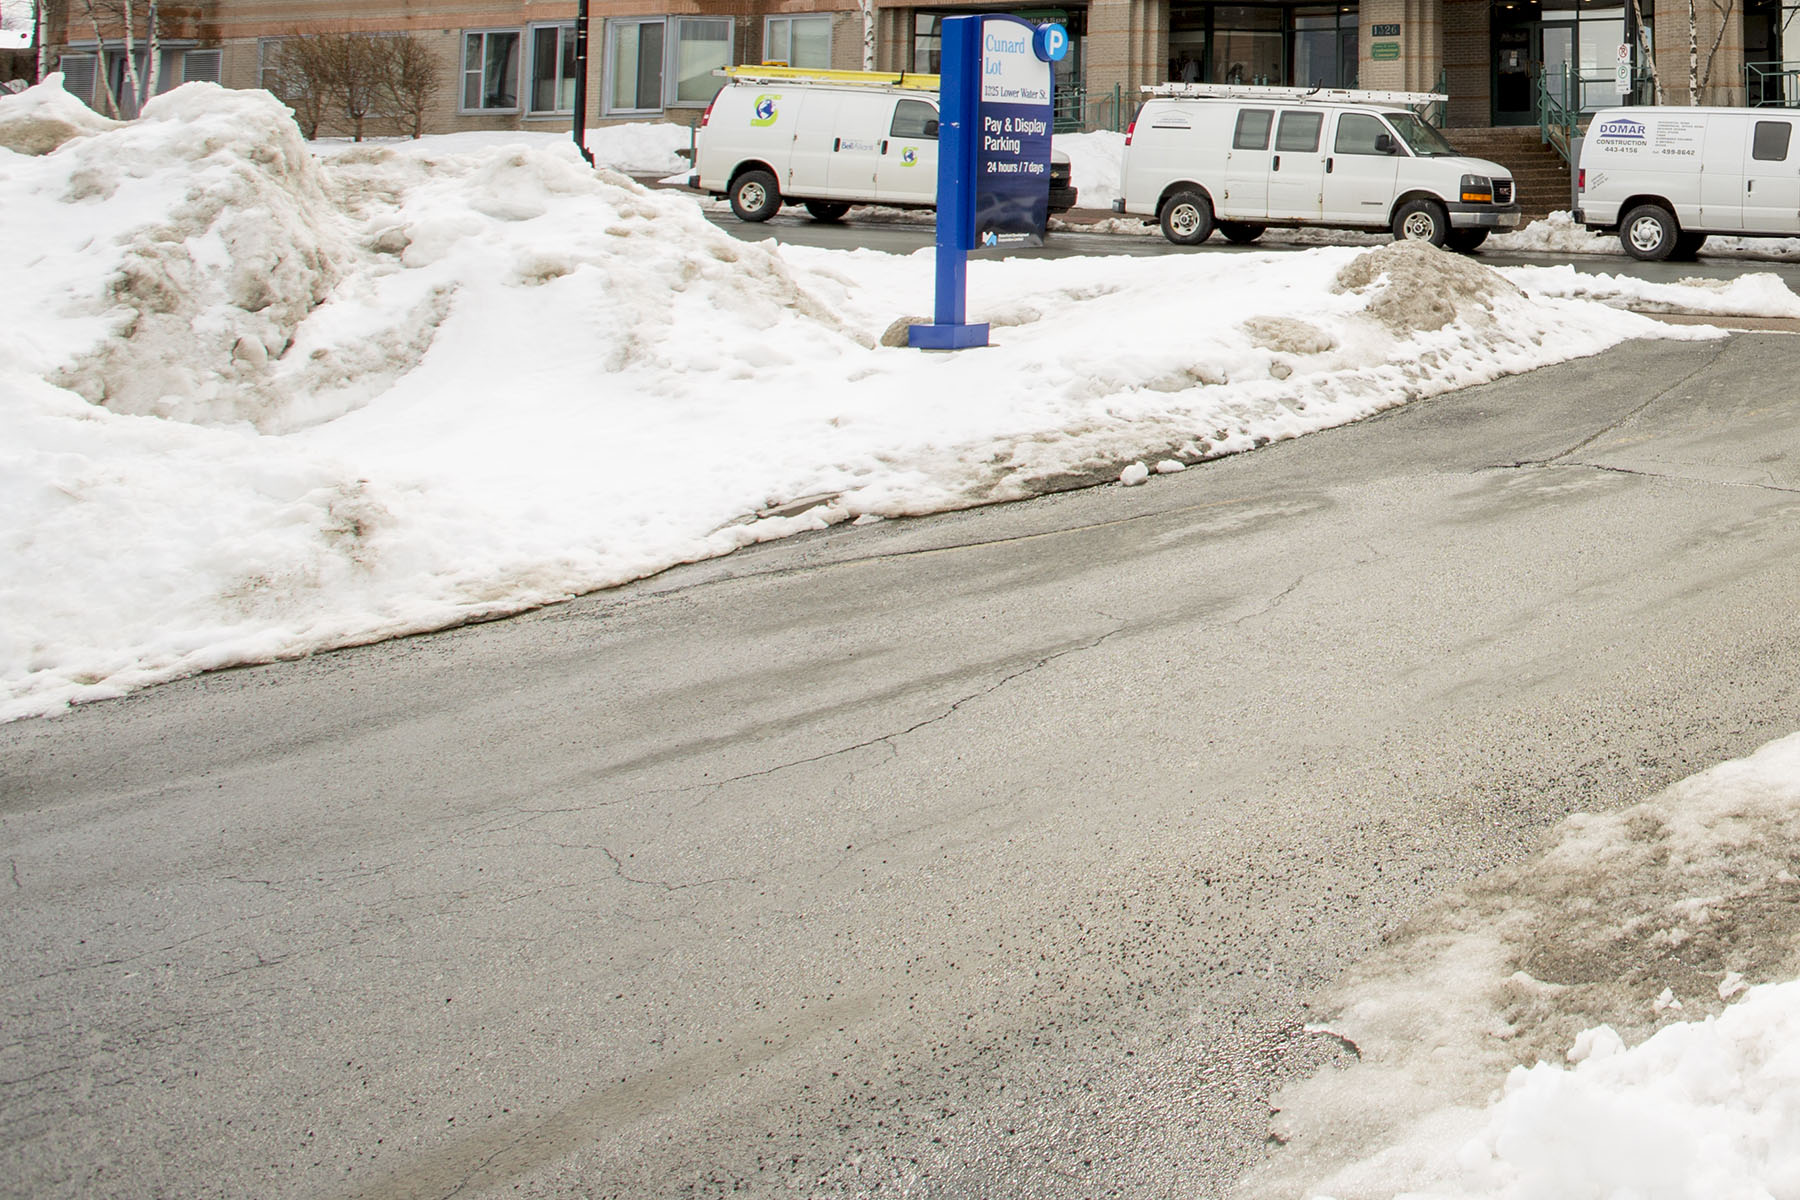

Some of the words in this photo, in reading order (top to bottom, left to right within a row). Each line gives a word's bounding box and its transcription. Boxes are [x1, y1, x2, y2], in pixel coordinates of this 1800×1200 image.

[985, 33, 1025, 55] Cunard
[1049, 29, 1064, 56] P
[985, 56, 1002, 76] Lot
[1000, 86, 1020, 98] Lower
[1020, 87, 1039, 99] Water
[984, 116, 1003, 135] Pay
[1004, 117, 1013, 132] &
[1014, 117, 1047, 136] Display
[1600, 124, 1646, 134] DOMAR
[984, 135, 1021, 155] Parking
[1596, 138, 1648, 147] CONSTRUCTION
[1604, 146, 1638, 154] 443-4156
[987, 161, 997, 173] 24
[998, 161, 1018, 173] hours
[1023, 161, 1029, 173] 7
[1028, 161, 1044, 175] days
